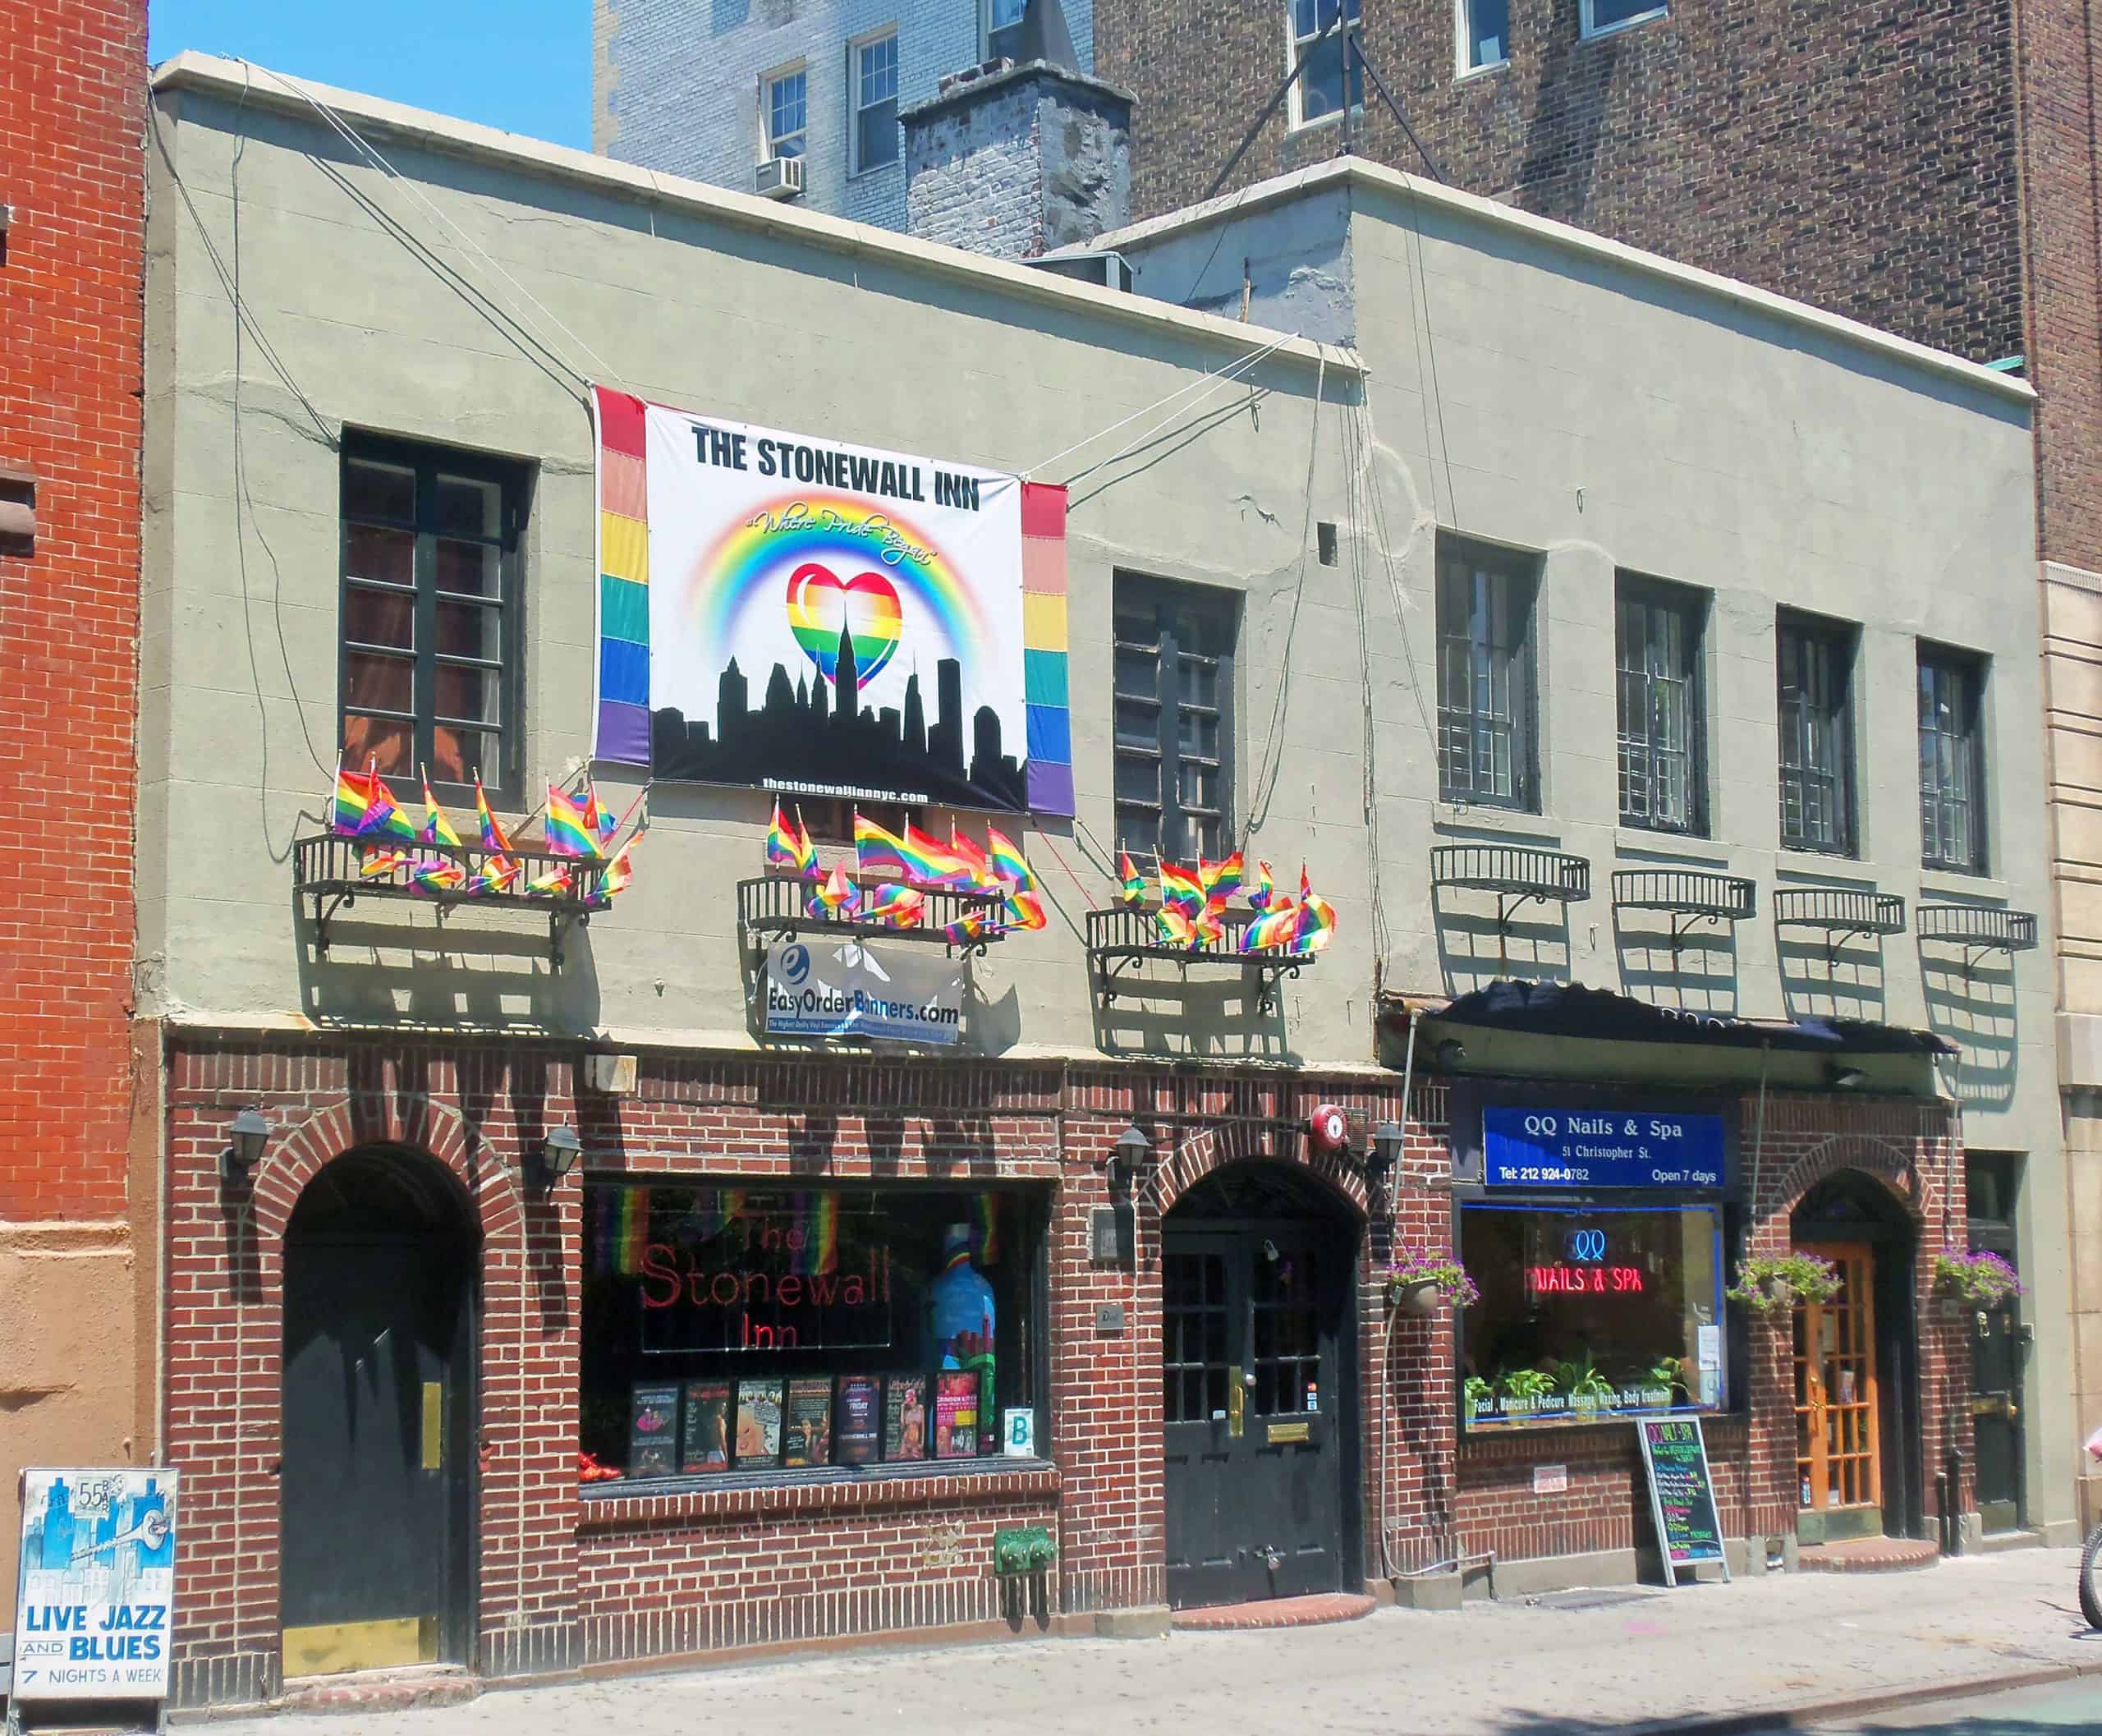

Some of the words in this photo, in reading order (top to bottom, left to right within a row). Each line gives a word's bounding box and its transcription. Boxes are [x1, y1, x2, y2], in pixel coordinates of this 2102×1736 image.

[691, 425, 747, 471] THE
[758, 439, 925, 503] STONEWALL
[934, 471, 980, 512] INN
[769, 987, 959, 1024] EasyOrderBanners.com
[1525, 1115, 1557, 1137] QQ
[1567, 1117, 1613, 1136] Nails
[1624, 1118, 1639, 1137] &
[1650, 1120, 1683, 1140] Spa
[1576, 1146, 1633, 1161] Christopher
[1638, 1147, 1652, 1159] St.
[1521, 1168, 1539, 1180] 212
[1541, 1168, 1590, 1181] 924-0782
[1652, 1169, 1681, 1183] Open
[1683, 1169, 1691, 1181] 7
[1692, 1169, 1717, 1183] days
[640, 1242, 890, 1308] Stonewall
[1535, 1267, 1585, 1291] NAILS
[1613, 1267, 1642, 1291] SPA
[742, 1313, 797, 1348] Inn
[1012, 1416, 1028, 1445] B
[79, 1482, 103, 1507] 55
[25, 1605, 87, 1631] LIVE
[99, 1605, 167, 1630] JAZZ
[22, 1642, 63, 1654] AND
[69, 1635, 161, 1660] BLUES
[22, 1670, 38, 1683] 7
[49, 1669, 107, 1683] NIGHTS
[112, 1669, 121, 1683] A
[126, 1669, 162, 1683] WEEK
